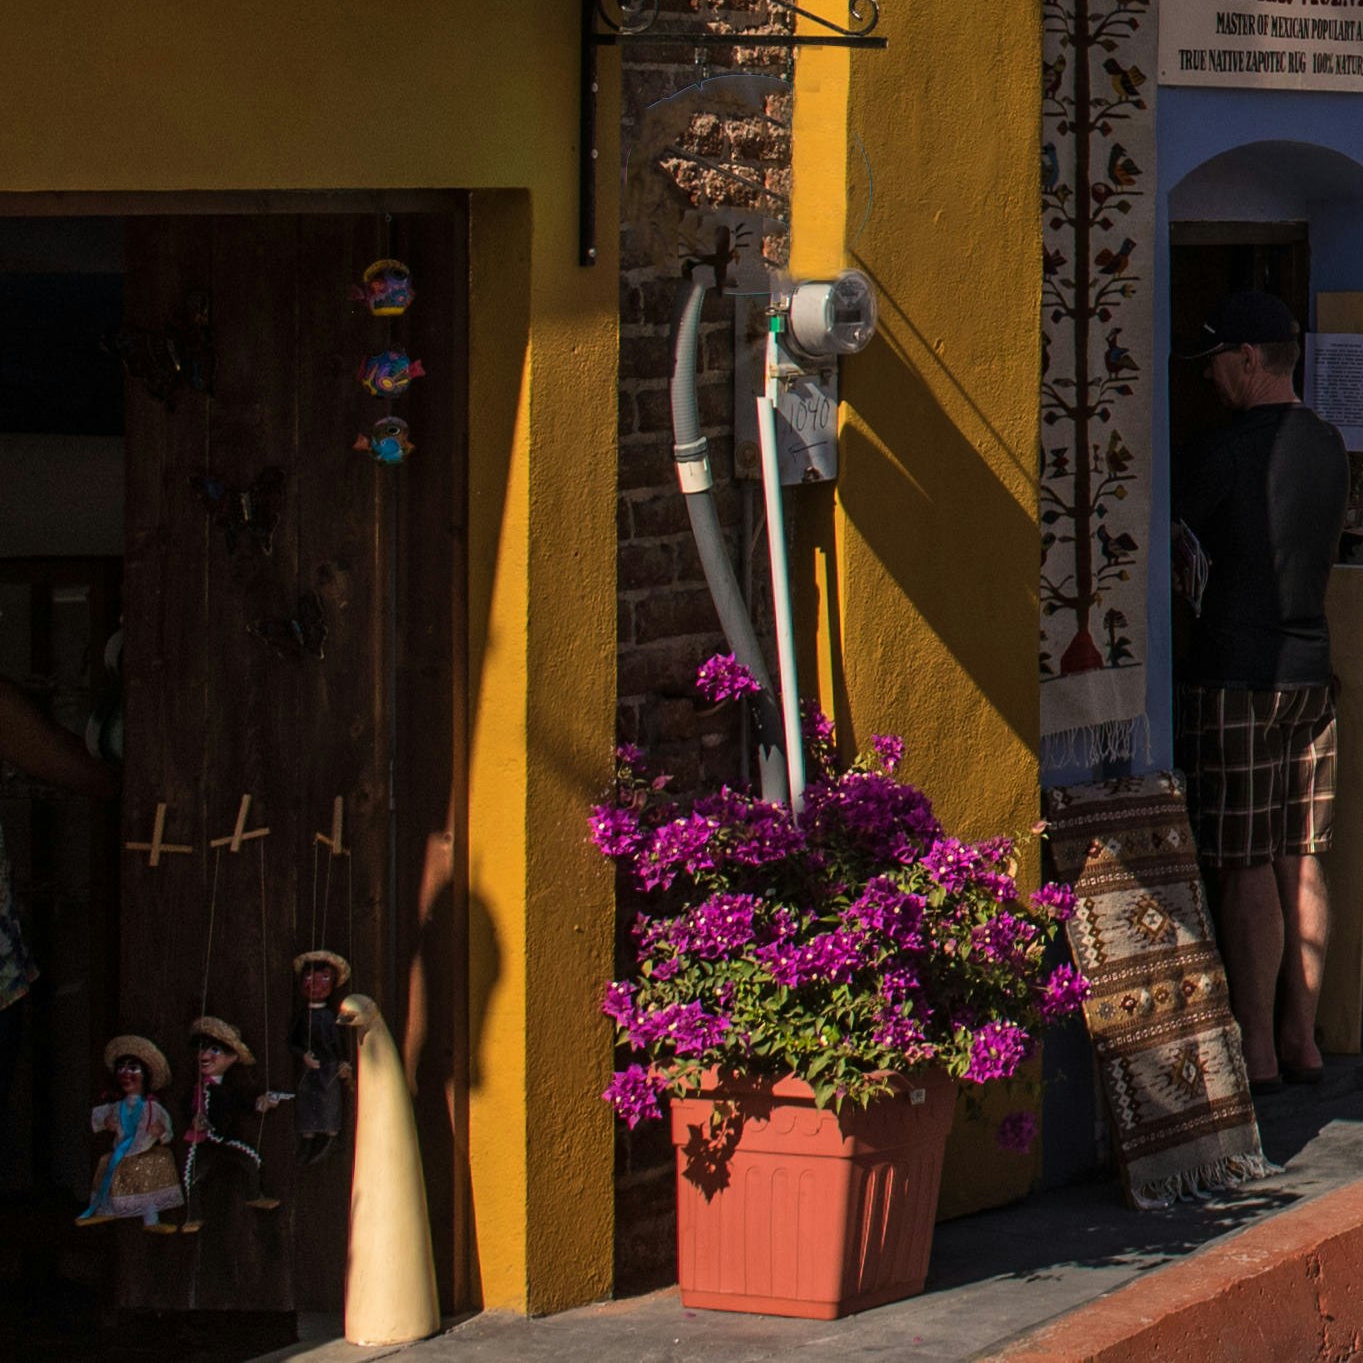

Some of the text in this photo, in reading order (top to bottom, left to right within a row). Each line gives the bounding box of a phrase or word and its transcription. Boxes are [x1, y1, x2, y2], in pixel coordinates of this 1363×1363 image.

[1216, 12, 1256, 36] MASTER
[1257, 16, 1269, 36] OF
[1271, 16, 1310, 39] MEXICAN
[1311, 18, 1356, 41] POPULART
[1179, 49, 1208, 71] TRUE
[1208, 49, 1245, 73] NATIVE
[1245, 50, 1287, 74] ZAPOTEC
[1288, 51, 1306, 74] RUG
[1312, 52, 1333, 75] 100%
[789, 397, 830, 433] 1040
